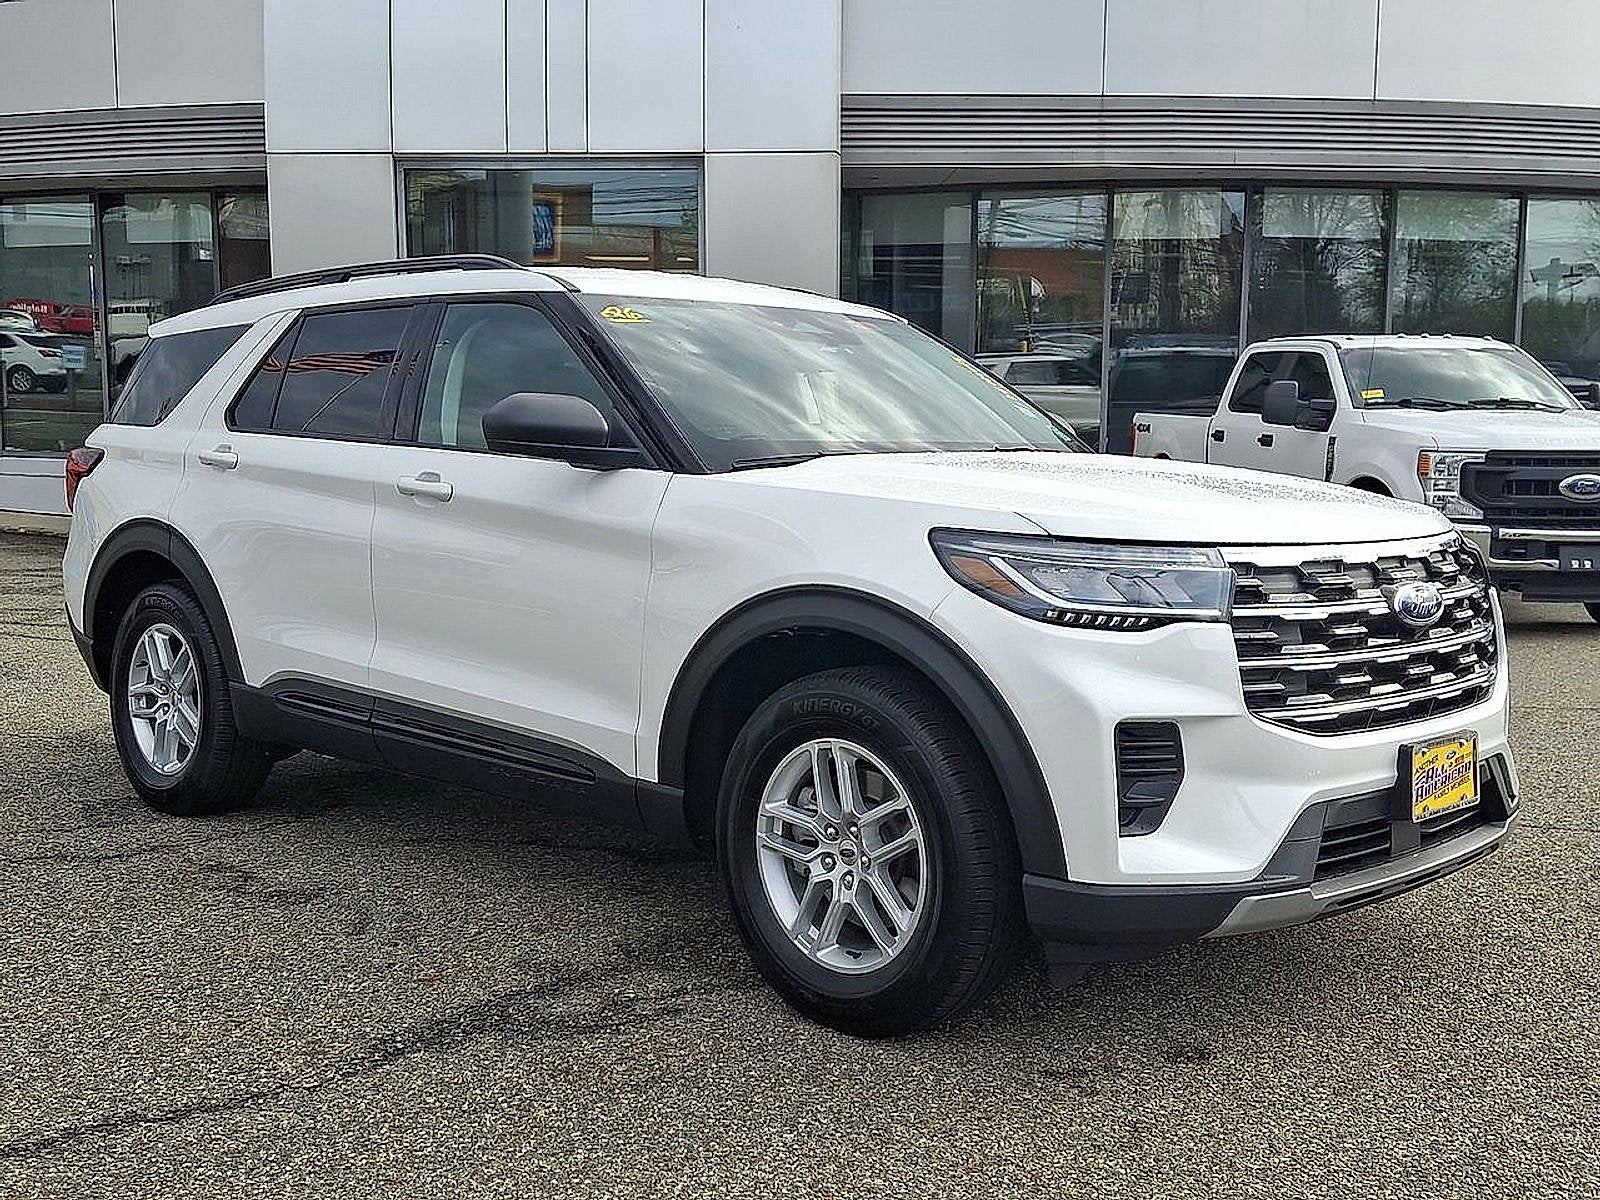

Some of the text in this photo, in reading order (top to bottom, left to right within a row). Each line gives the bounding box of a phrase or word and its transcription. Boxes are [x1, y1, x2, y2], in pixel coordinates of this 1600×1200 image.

[1404, 586, 1440, 615] Ford
[1415, 761, 1471, 803] AMERICAN
[1425, 763, 1448, 784] ALL
